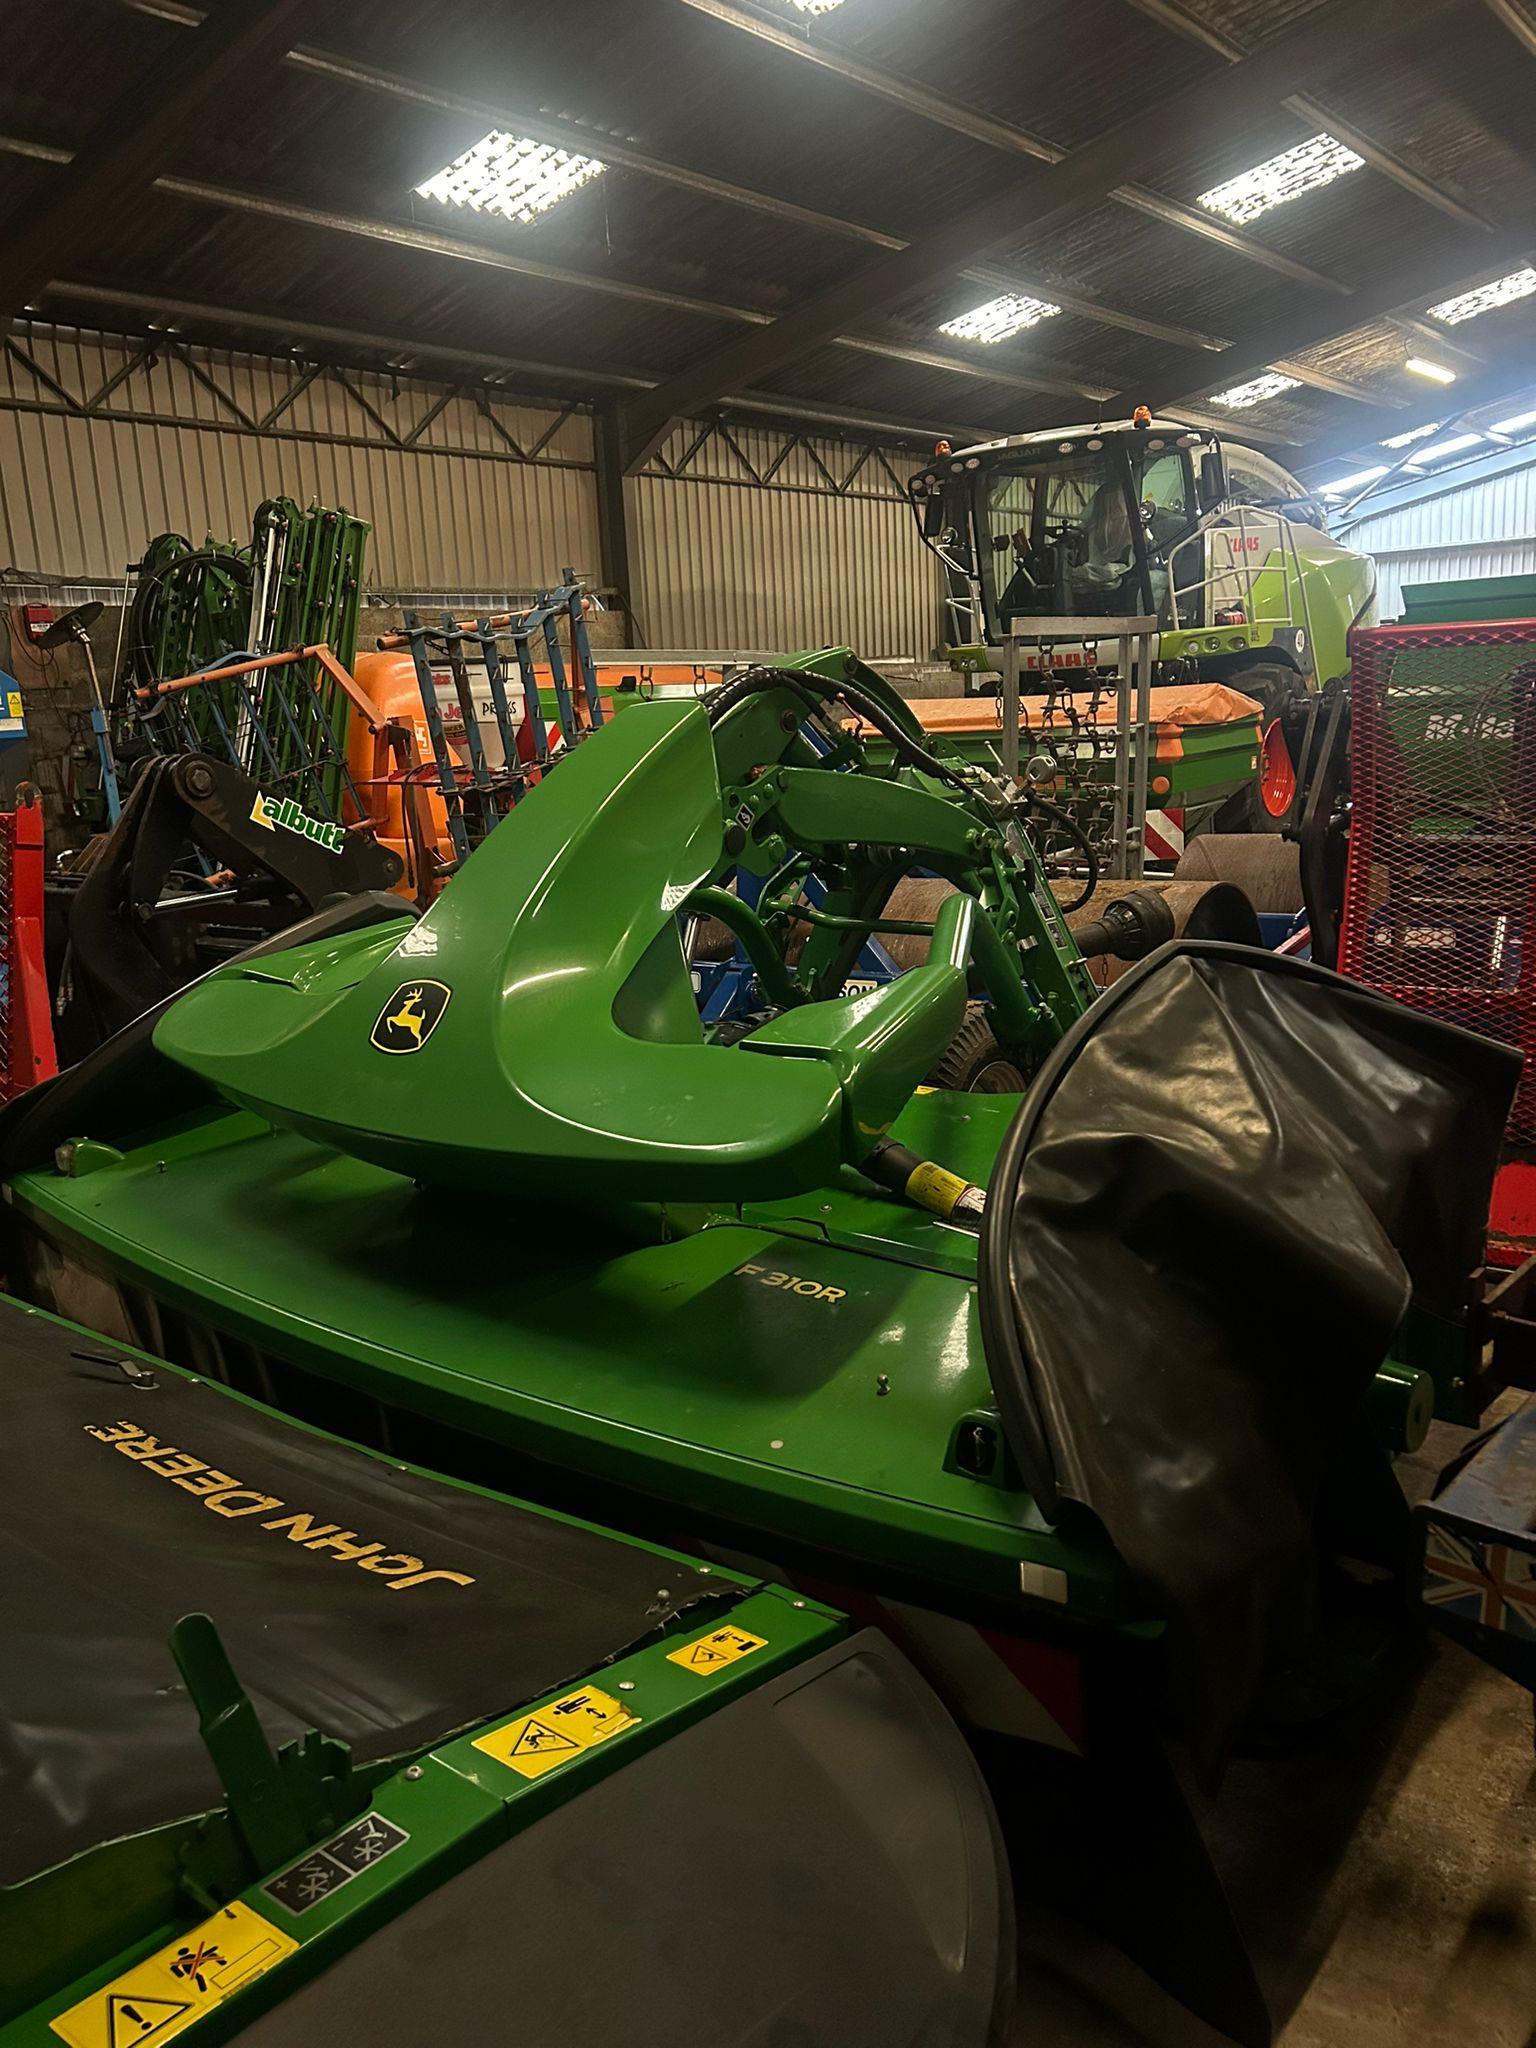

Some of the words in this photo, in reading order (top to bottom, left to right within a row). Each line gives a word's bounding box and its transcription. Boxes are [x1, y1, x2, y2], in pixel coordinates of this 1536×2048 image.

[482, 701, 517, 716] PRSS
[262, 797, 345, 854] albutt
[83, 1420, 285, 1518] DEERE
[261, 1513, 476, 1590] JOHN
